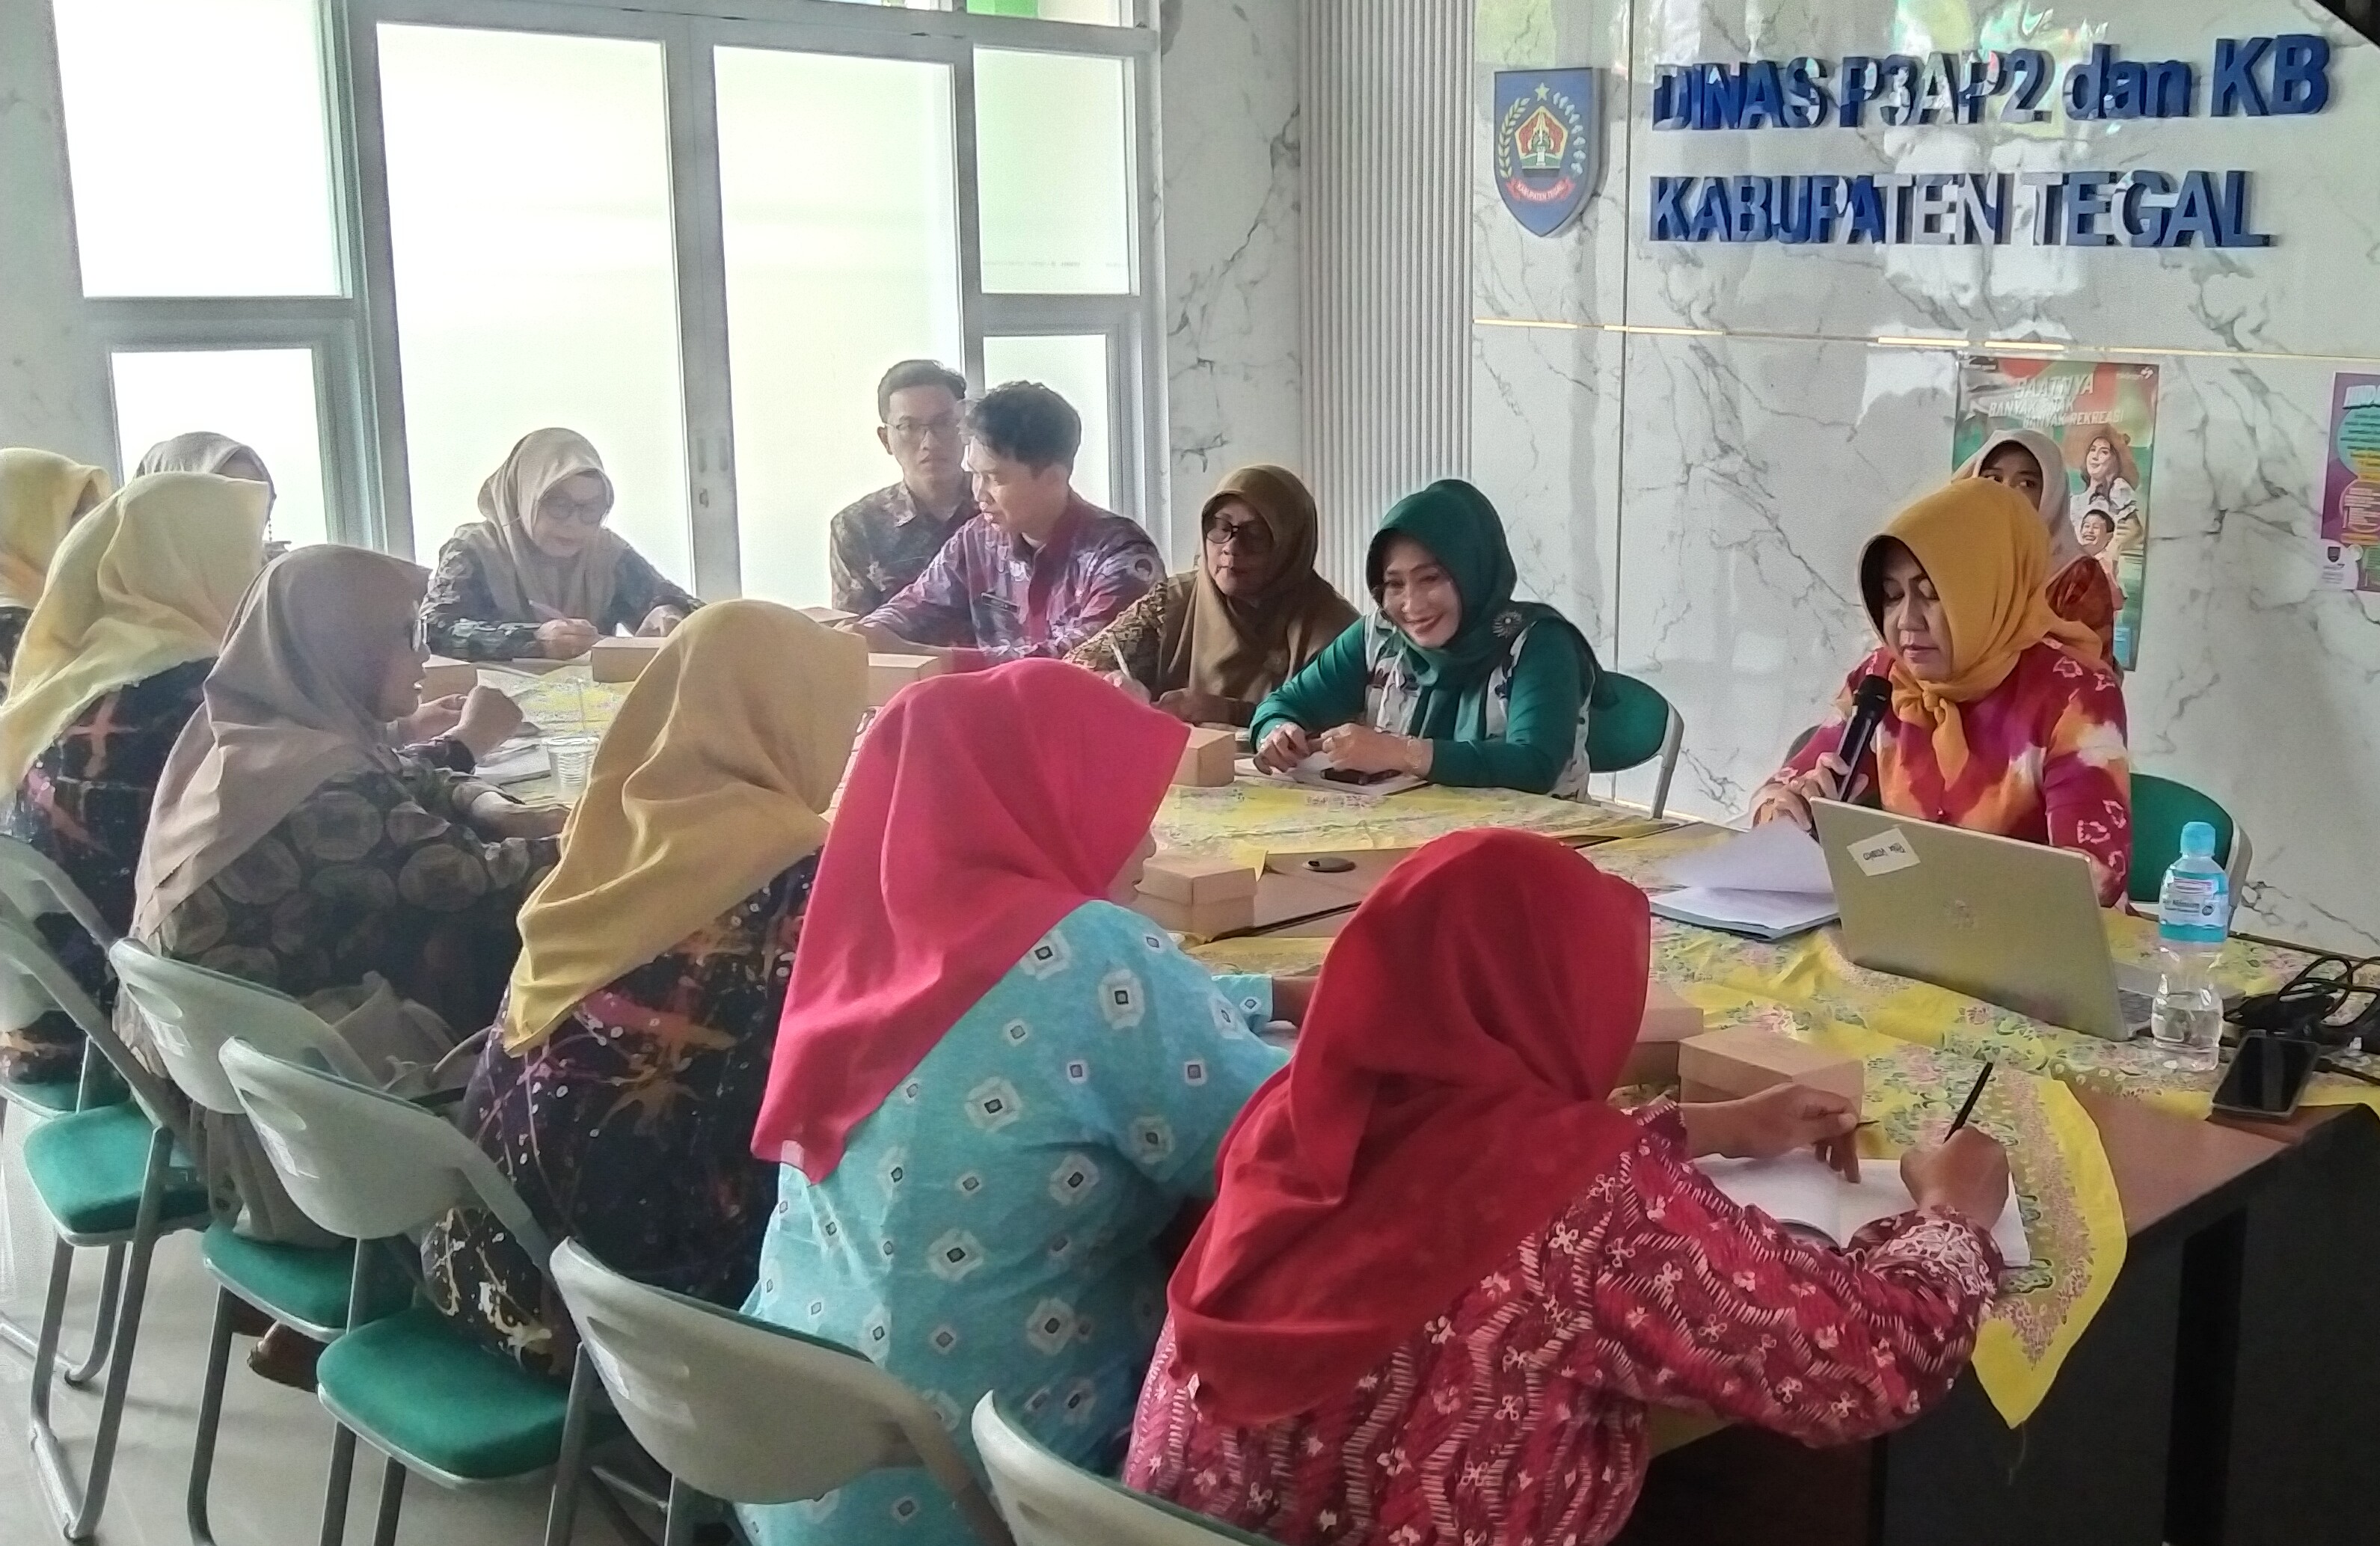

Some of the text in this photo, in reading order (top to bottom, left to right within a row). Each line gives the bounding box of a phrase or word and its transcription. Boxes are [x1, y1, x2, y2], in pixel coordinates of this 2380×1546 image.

[1652, 34, 2330, 130] DINAS P3AP2 dan KB
[1649, 170, 2278, 248] KABUPATEN TEGAL
